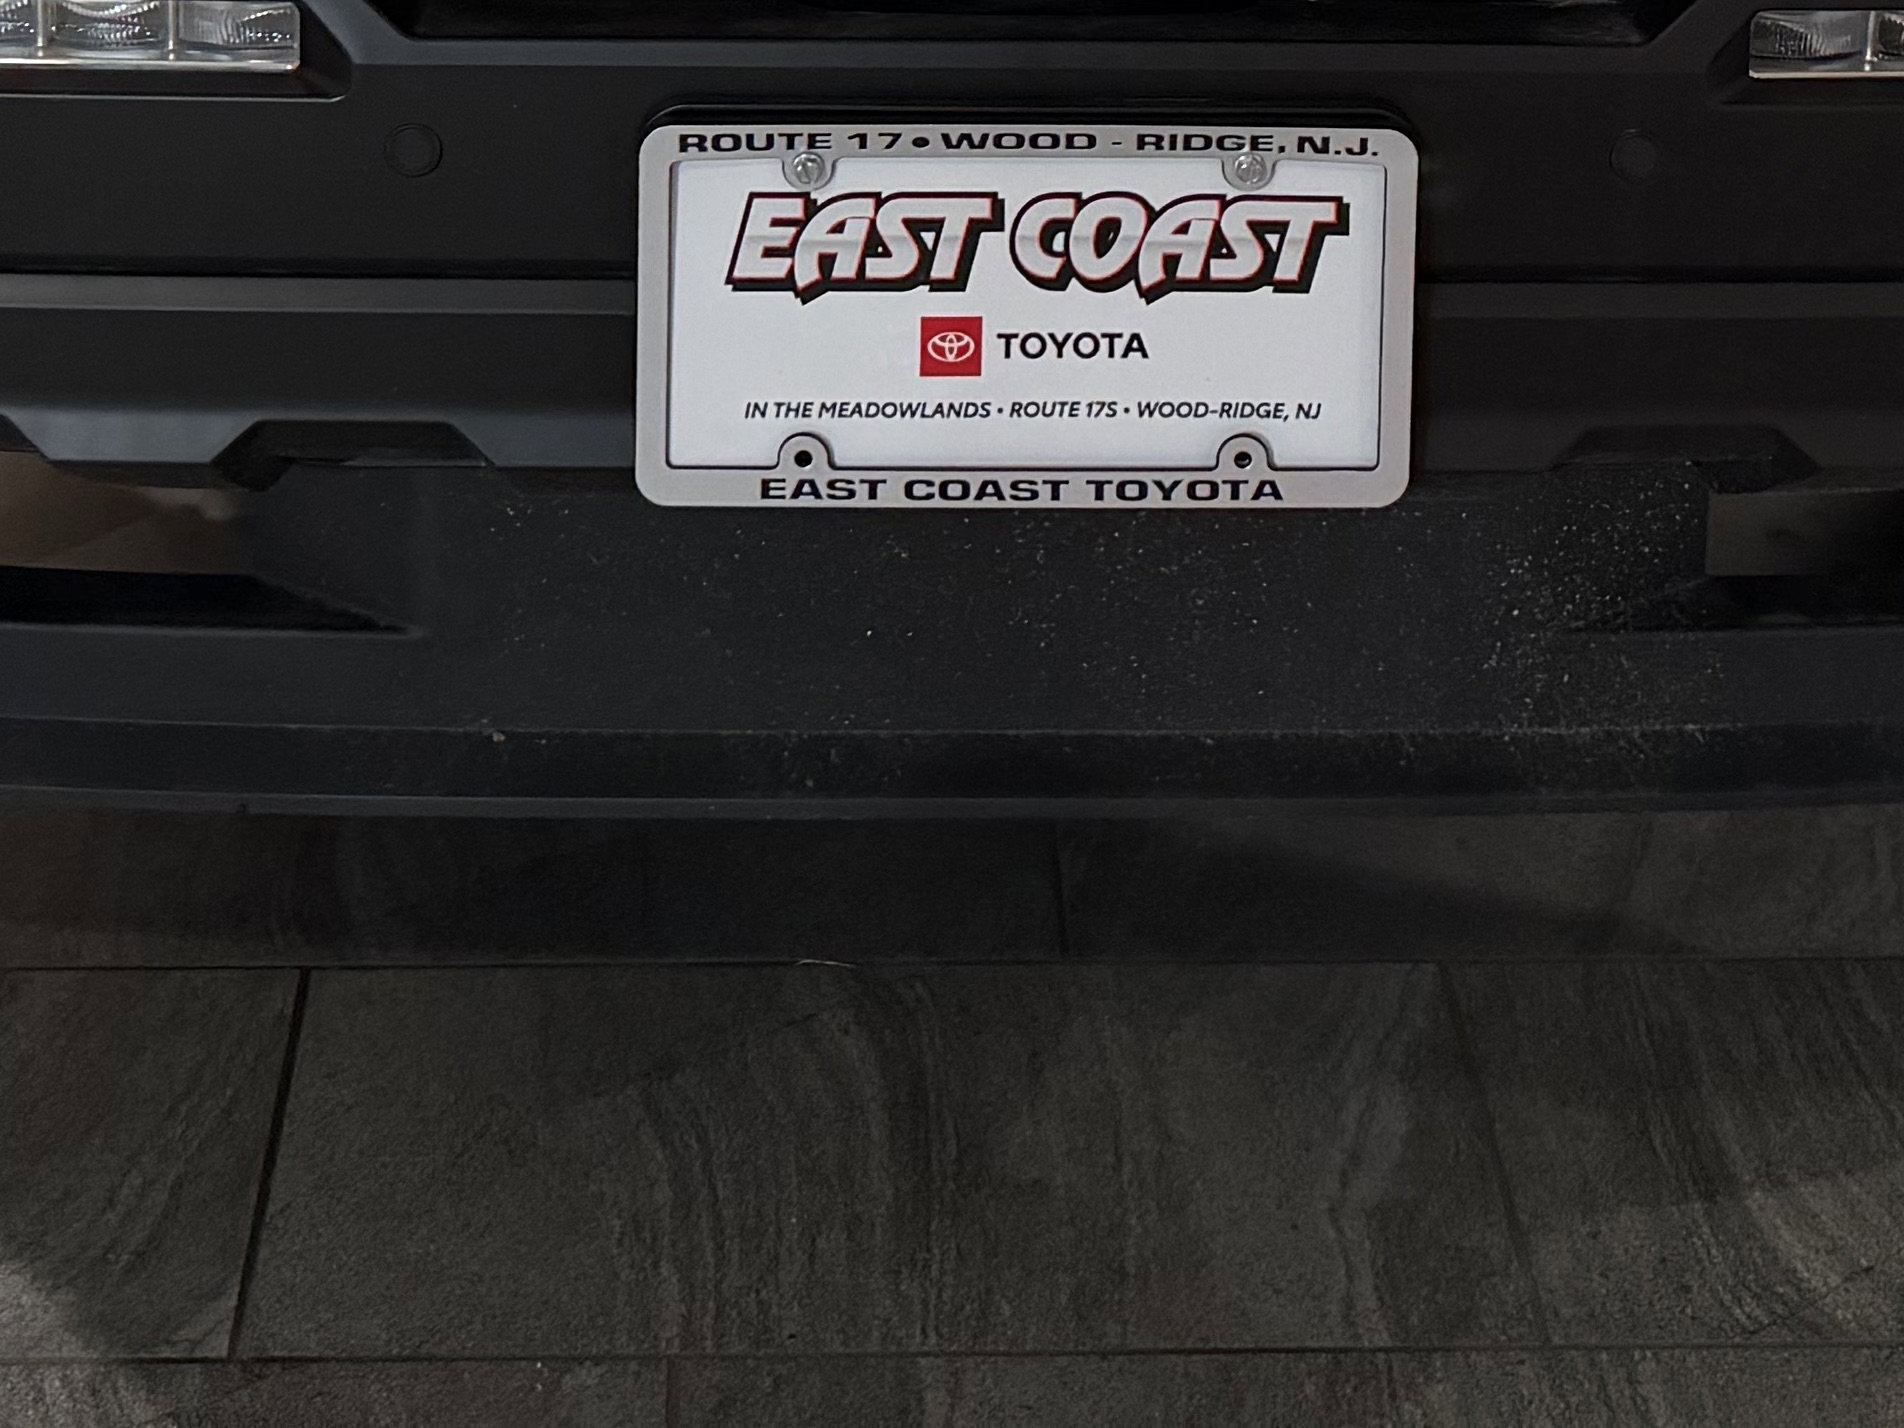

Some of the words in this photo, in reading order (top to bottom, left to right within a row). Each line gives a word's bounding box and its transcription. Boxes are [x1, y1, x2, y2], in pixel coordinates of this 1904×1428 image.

[679, 133, 833, 155] ROUTE
[940, 133, 1097, 152] WOOD
[1136, 133, 1291, 158] RIDGE,
[1297, 136, 1380, 158] N.J.
[725, 191, 1004, 306] EAST
[1009, 191, 1351, 308] COAST
[997, 331, 1149, 362] TOYOTA
[744, 401, 768, 420] IN
[772, 401, 813, 420] THE
[817, 399, 993, 421] MEADOWLANDS
[1009, 399, 1081, 420] ROUTE
[1084, 400, 1119, 420] 17S
[1136, 400, 1291, 425] WOOD-RIDGE,
[1296, 401, 1322, 422] NJ
[760, 477, 888, 503] EAST
[903, 479, 1071, 504] COAST
[1085, 479, 1284, 504] TOYOTA
